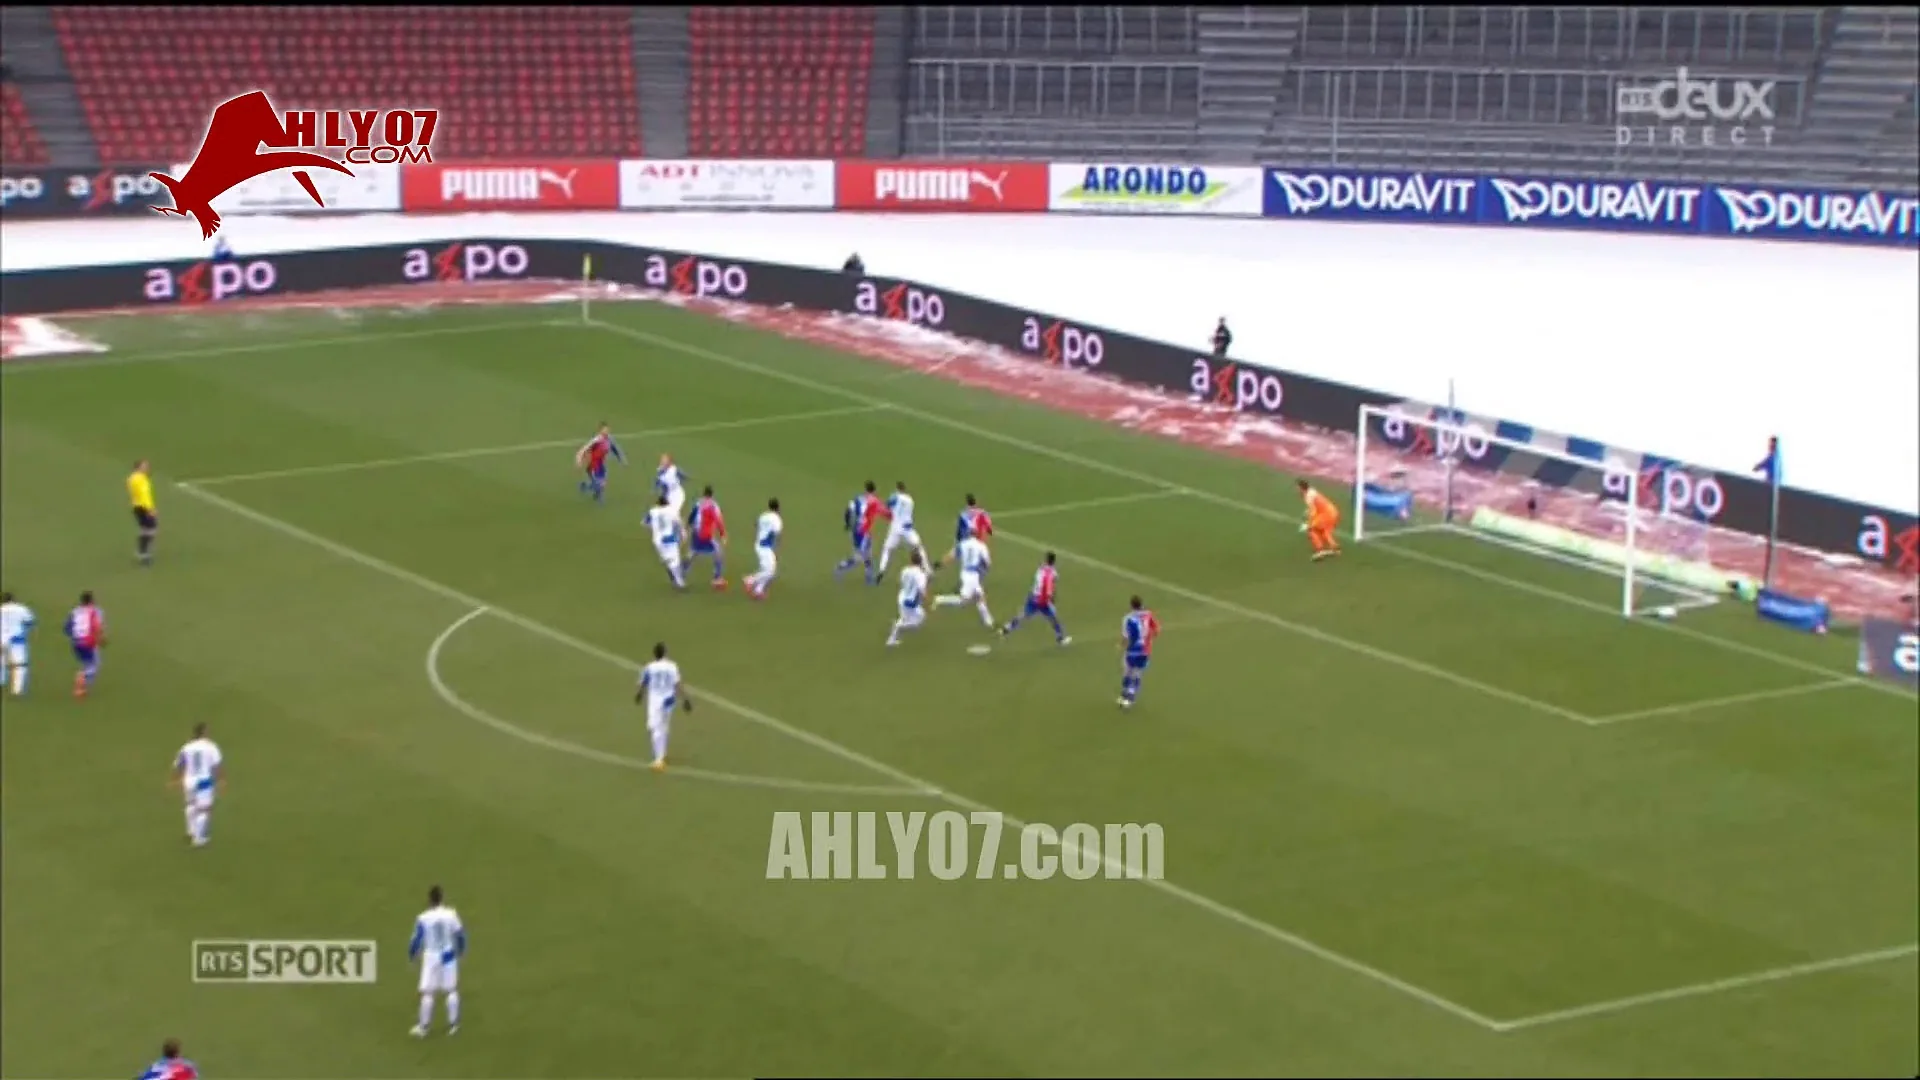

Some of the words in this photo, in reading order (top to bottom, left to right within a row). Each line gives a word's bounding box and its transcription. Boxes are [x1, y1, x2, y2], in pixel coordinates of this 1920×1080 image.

[442, 169, 535, 200] PUMA
[875, 169, 968, 199] PUMA
[1083, 165, 1207, 195] ARONDO
[1331, 172, 1475, 214] DURAVIT
[1550, 178, 1699, 223] DURAVIT
[144, 258, 277, 303] axpo
[403, 241, 529, 284] axpo
[645, 255, 747, 299] axpo
[855, 281, 944, 327] axpo
[1022, 316, 1102, 368] axpo
[1190, 357, 1283, 412] axpo
